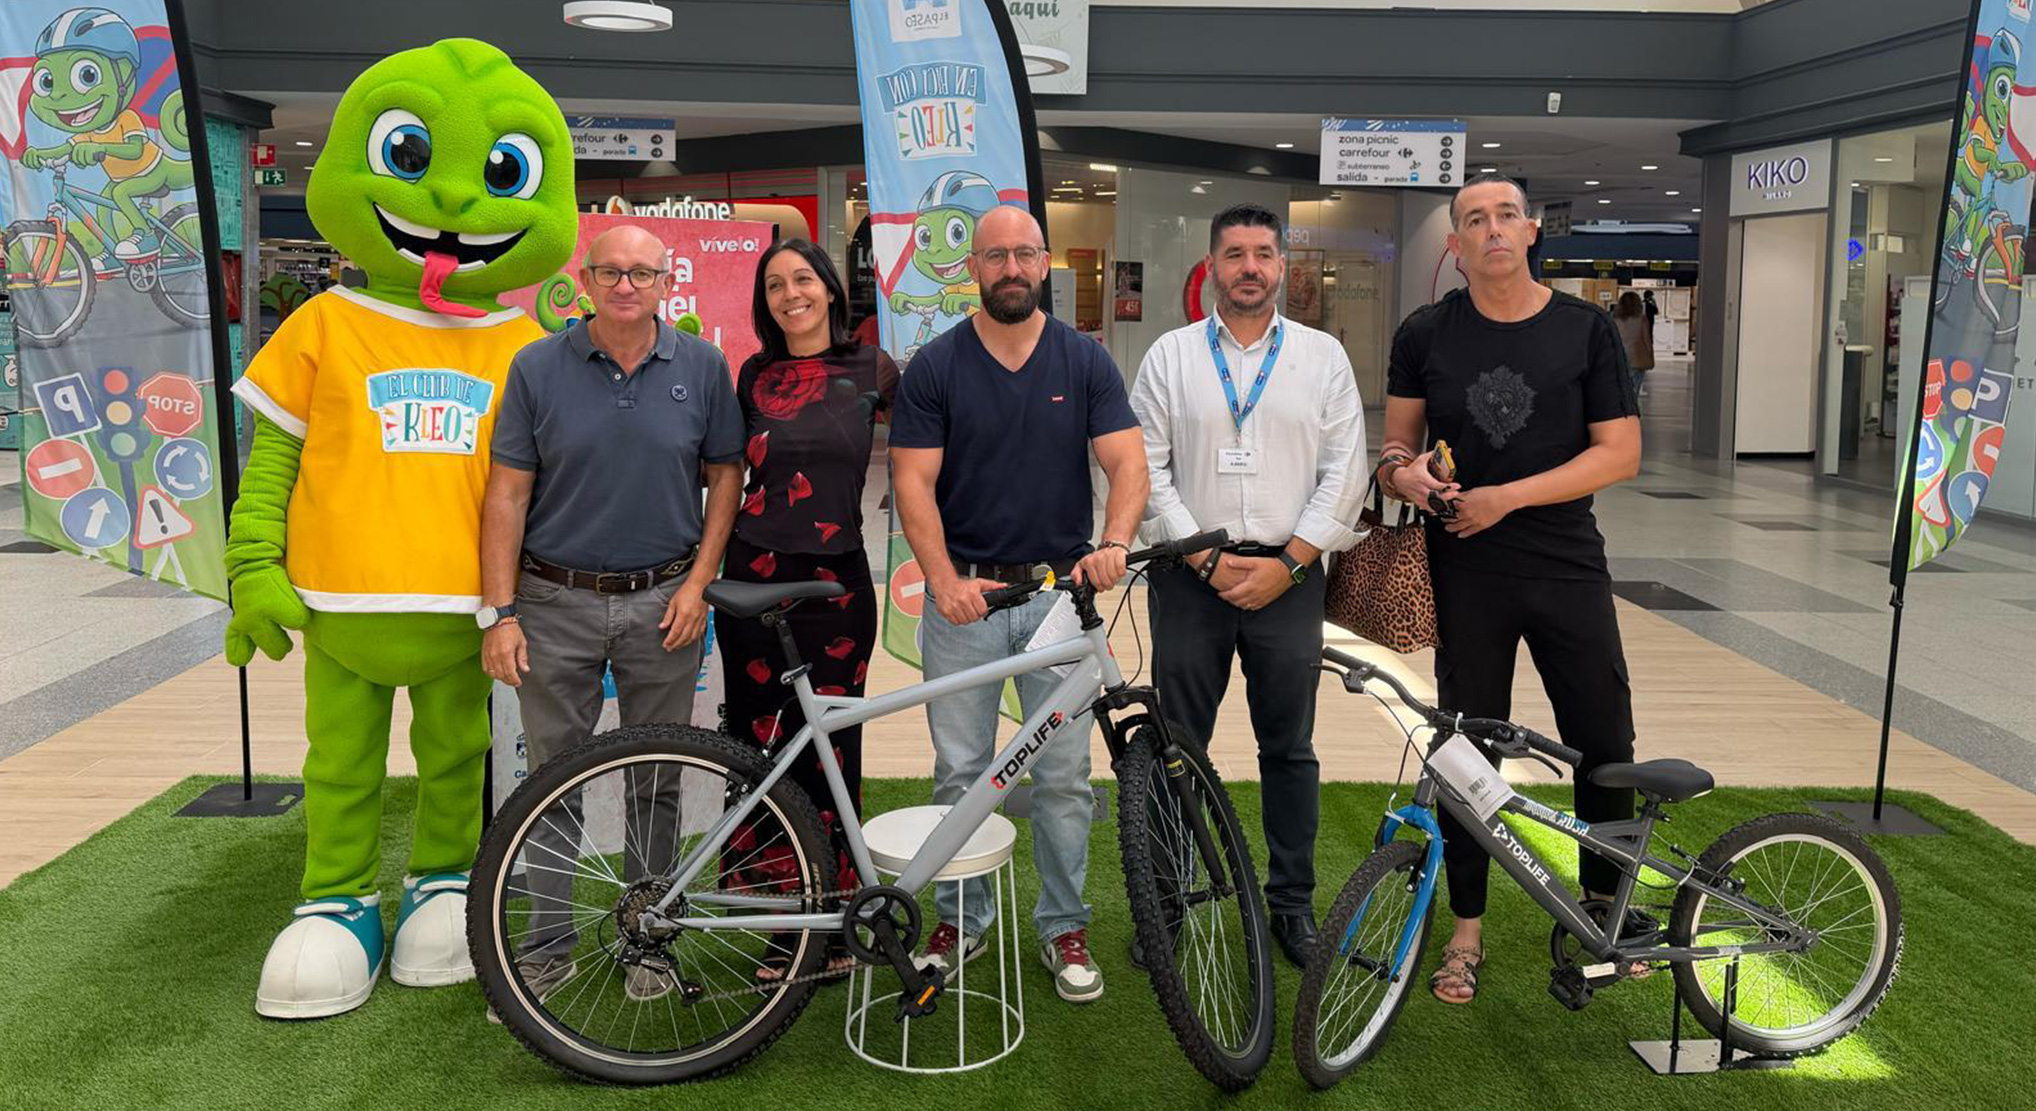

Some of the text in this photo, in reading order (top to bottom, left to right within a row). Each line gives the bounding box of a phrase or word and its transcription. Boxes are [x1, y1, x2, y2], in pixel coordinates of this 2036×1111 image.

[571, 132, 606, 143] refour
[1339, 135, 1399, 146] zona picnic
[1339, 148, 1391, 158] carrefour
[1336, 172, 1368, 182] salida
[1747, 156, 1808, 190] KIKO
[634, 196, 731, 220] vodafone
[387, 374, 474, 404] EL CLUB DE
[1971, 376, 2001, 410] P
[403, 402, 462, 443] KLEO
[994, 711, 1062, 786] TOPLIFE
[1506, 835, 1551, 886] TOPLIFE
